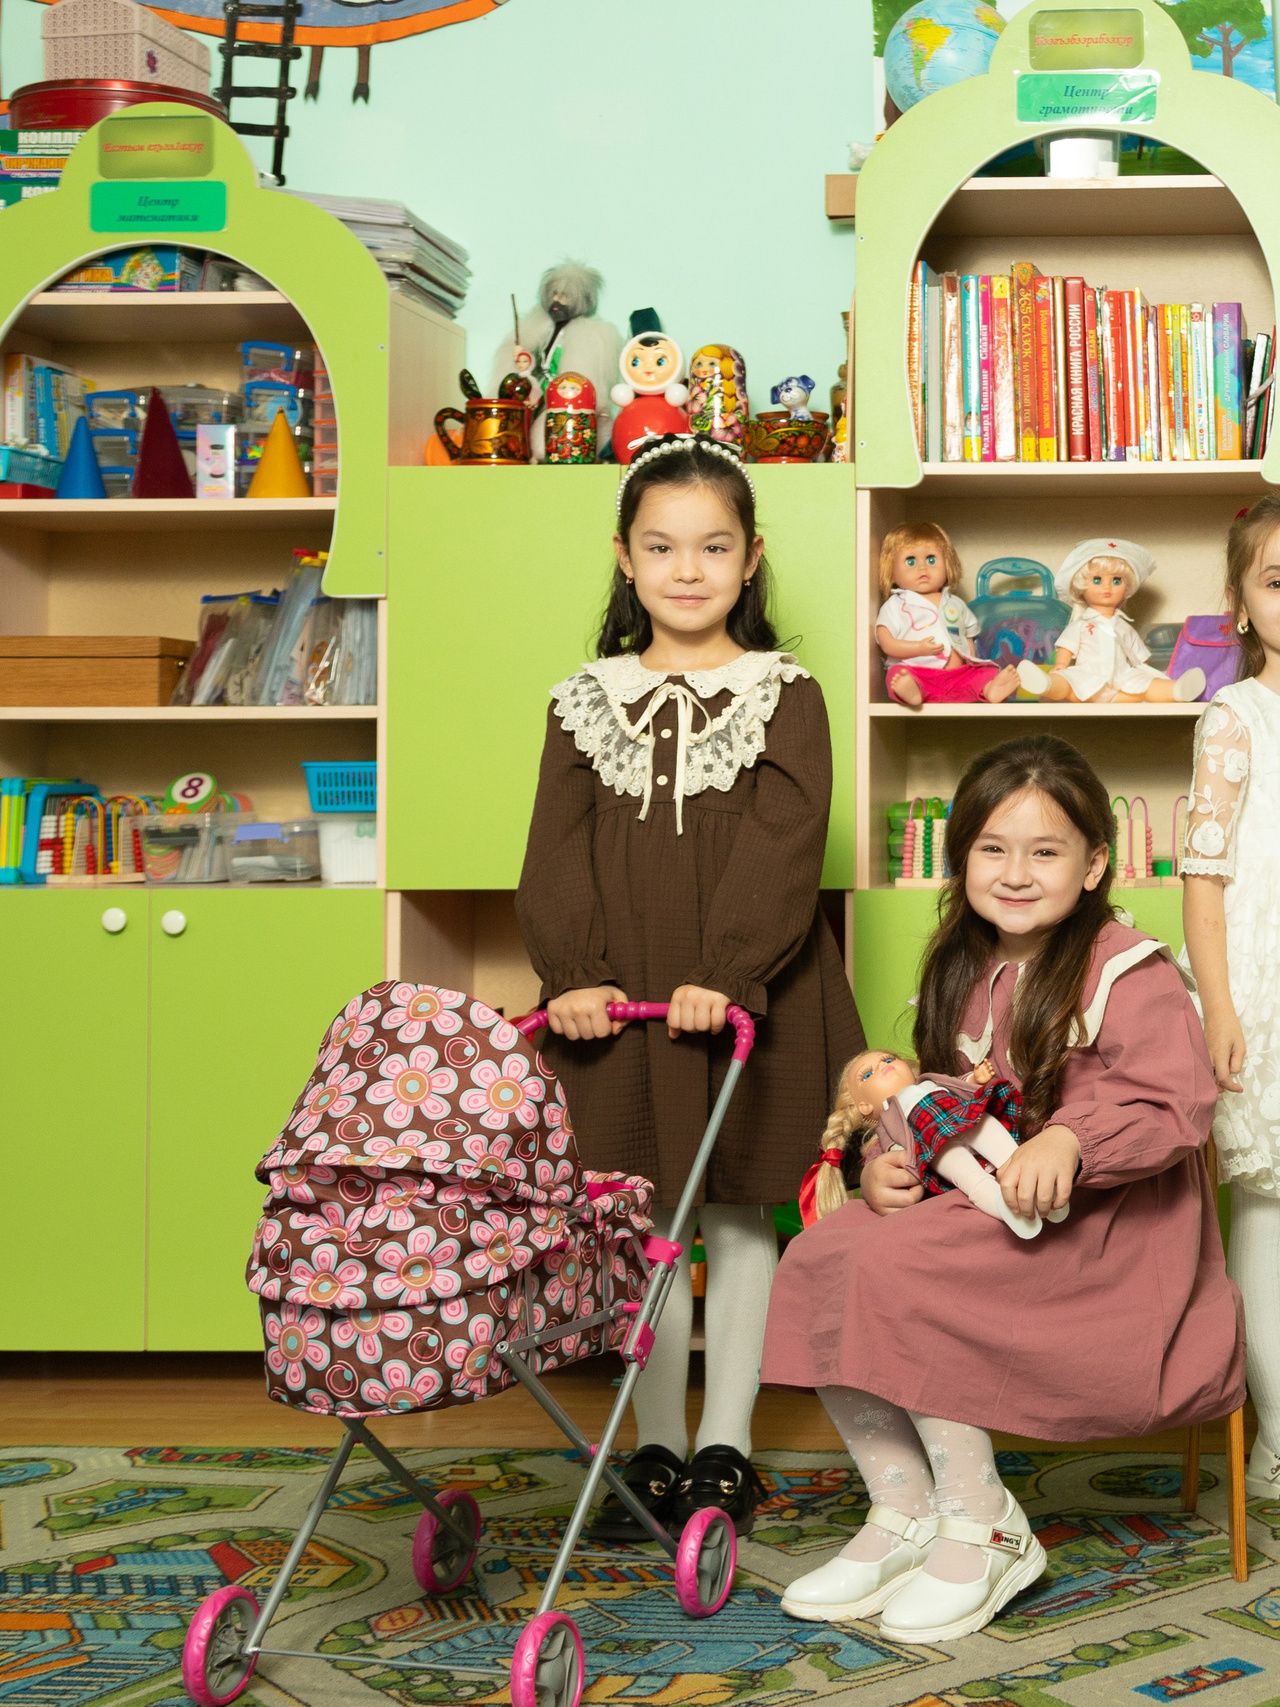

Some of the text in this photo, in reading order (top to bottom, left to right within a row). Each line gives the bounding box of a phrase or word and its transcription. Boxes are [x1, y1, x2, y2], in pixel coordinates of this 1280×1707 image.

[1063, 85, 1109, 100] Центр
[137, 196, 179, 208] Центр
[1019, 288, 1031, 314] 365
[1021, 315, 1032, 359] СКАЗОК
[1088, 329, 1096, 359] СКАЗКИ
[1222, 313, 1230, 349] СЛОВАРИК
[1068, 304, 1084, 436] КРАСНАЯ КНИГА РОССИИ
[979, 325, 990, 454] Редьярд Киплинг Сказки
[181, 777, 203, 799] 8
[993, 1531, 1020, 1546] KING'S
